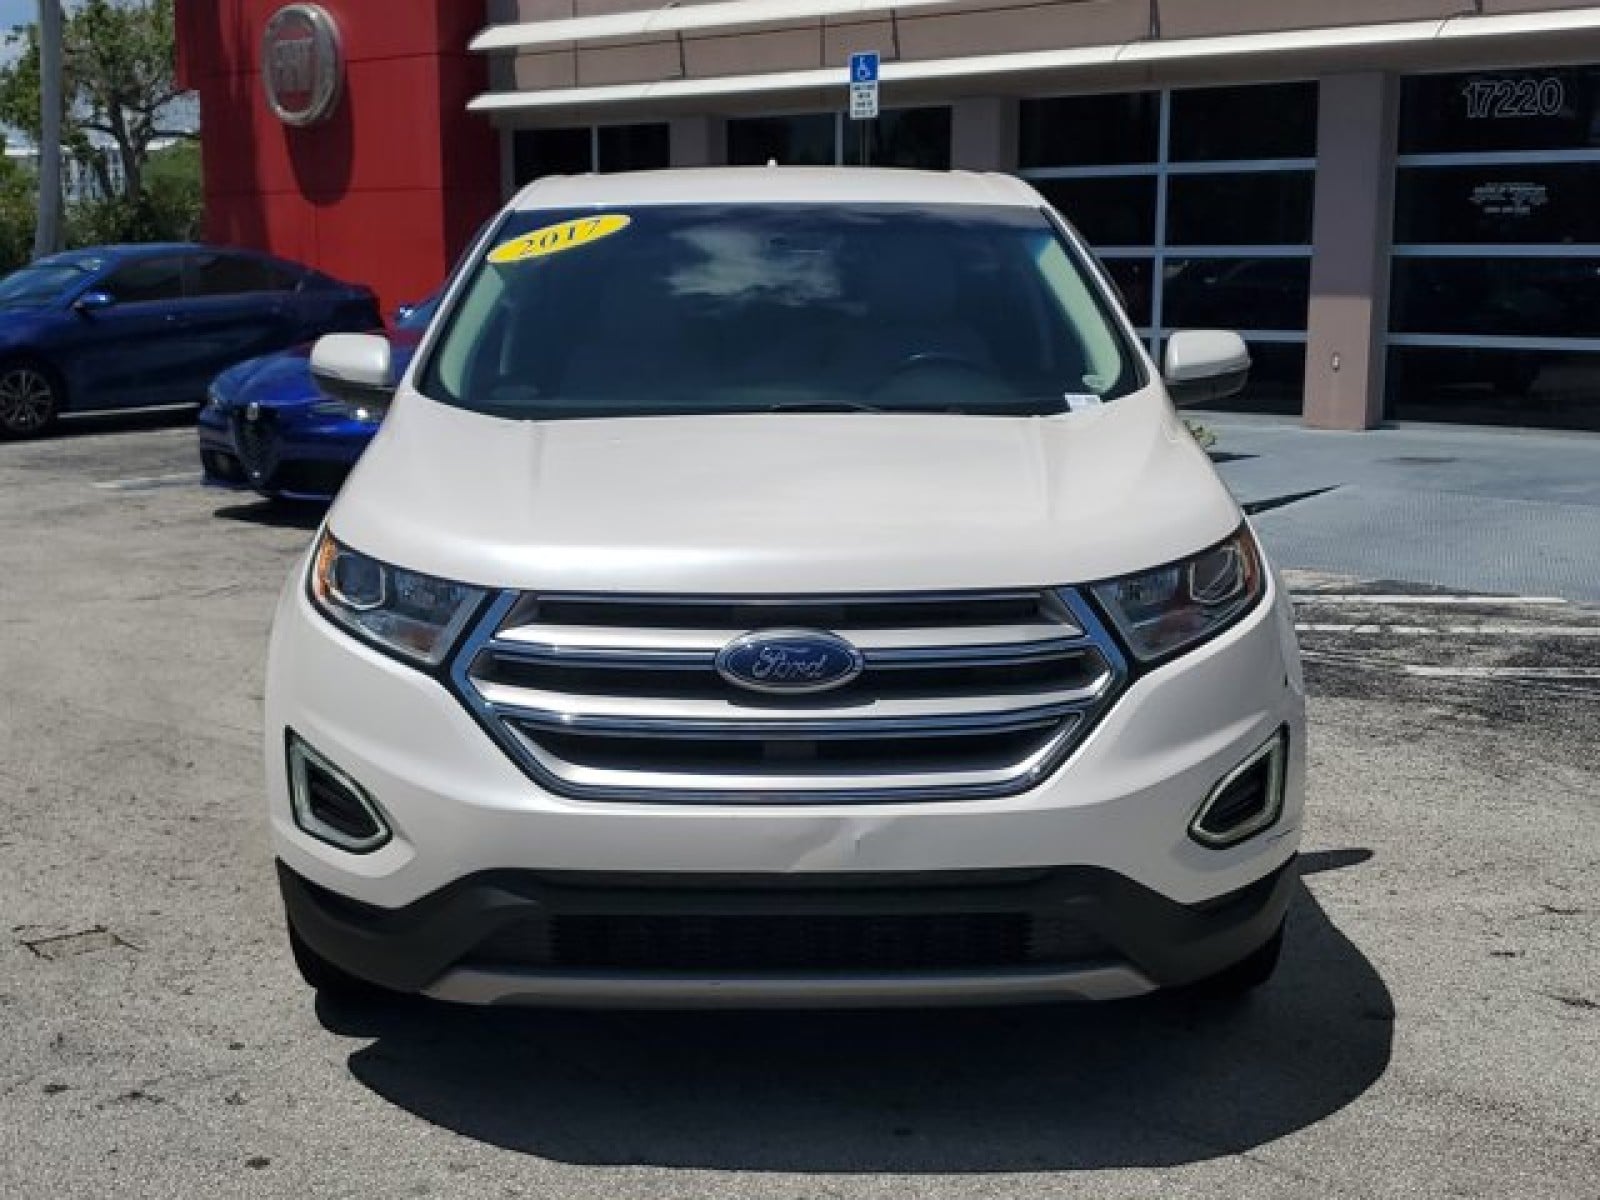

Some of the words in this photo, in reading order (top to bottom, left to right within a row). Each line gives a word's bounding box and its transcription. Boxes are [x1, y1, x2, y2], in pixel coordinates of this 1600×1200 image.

[1462, 78, 1562, 118] 17220
[520, 219, 602, 256] 2017
[752, 648, 828, 678] Ford
